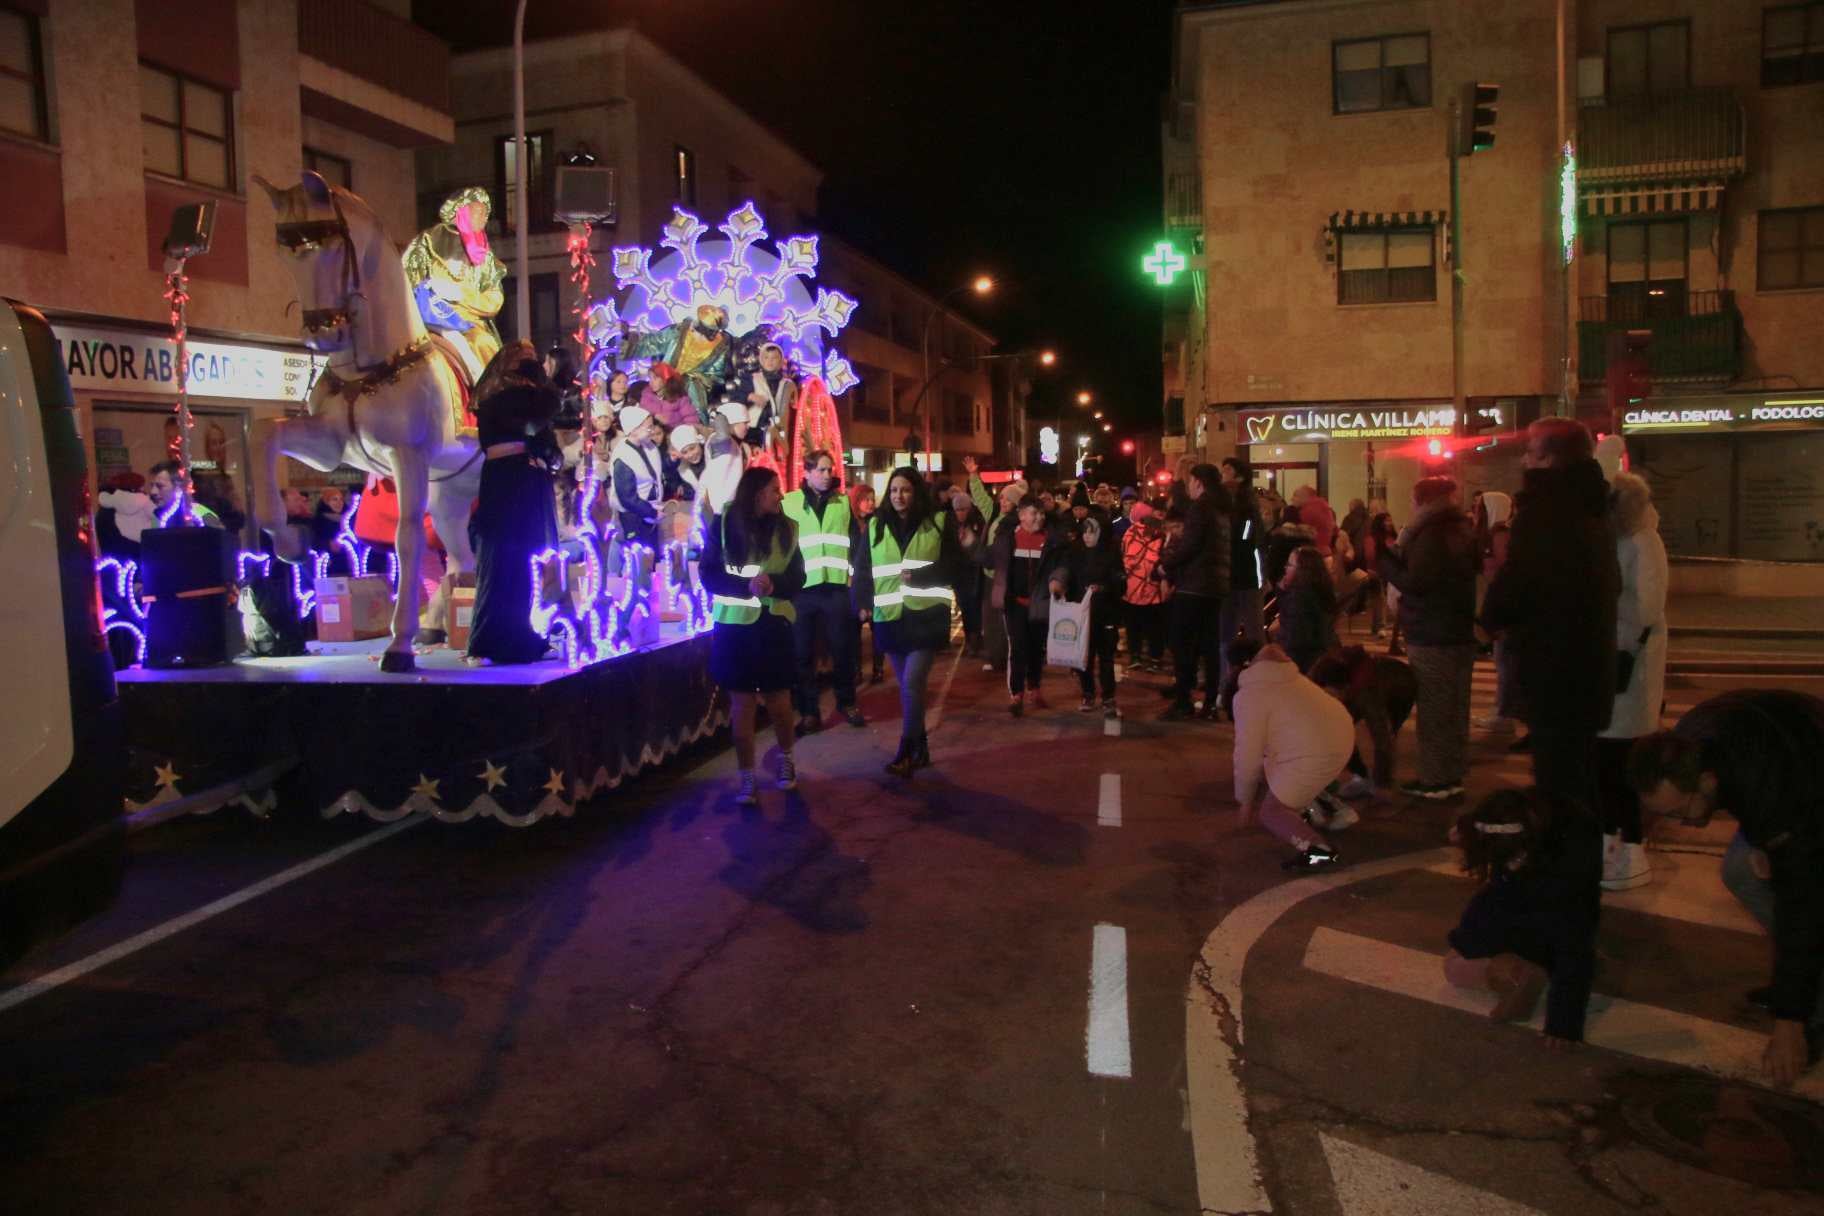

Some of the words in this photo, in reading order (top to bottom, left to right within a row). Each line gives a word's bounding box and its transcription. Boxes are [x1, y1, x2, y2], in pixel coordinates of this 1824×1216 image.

[144, 347, 264, 388] ABGADS
[1281, 410, 1366, 430] CLÍNICA
[1625, 410, 1679, 424] CLÍNICA
[1681, 408, 1734, 422] DENTAL
